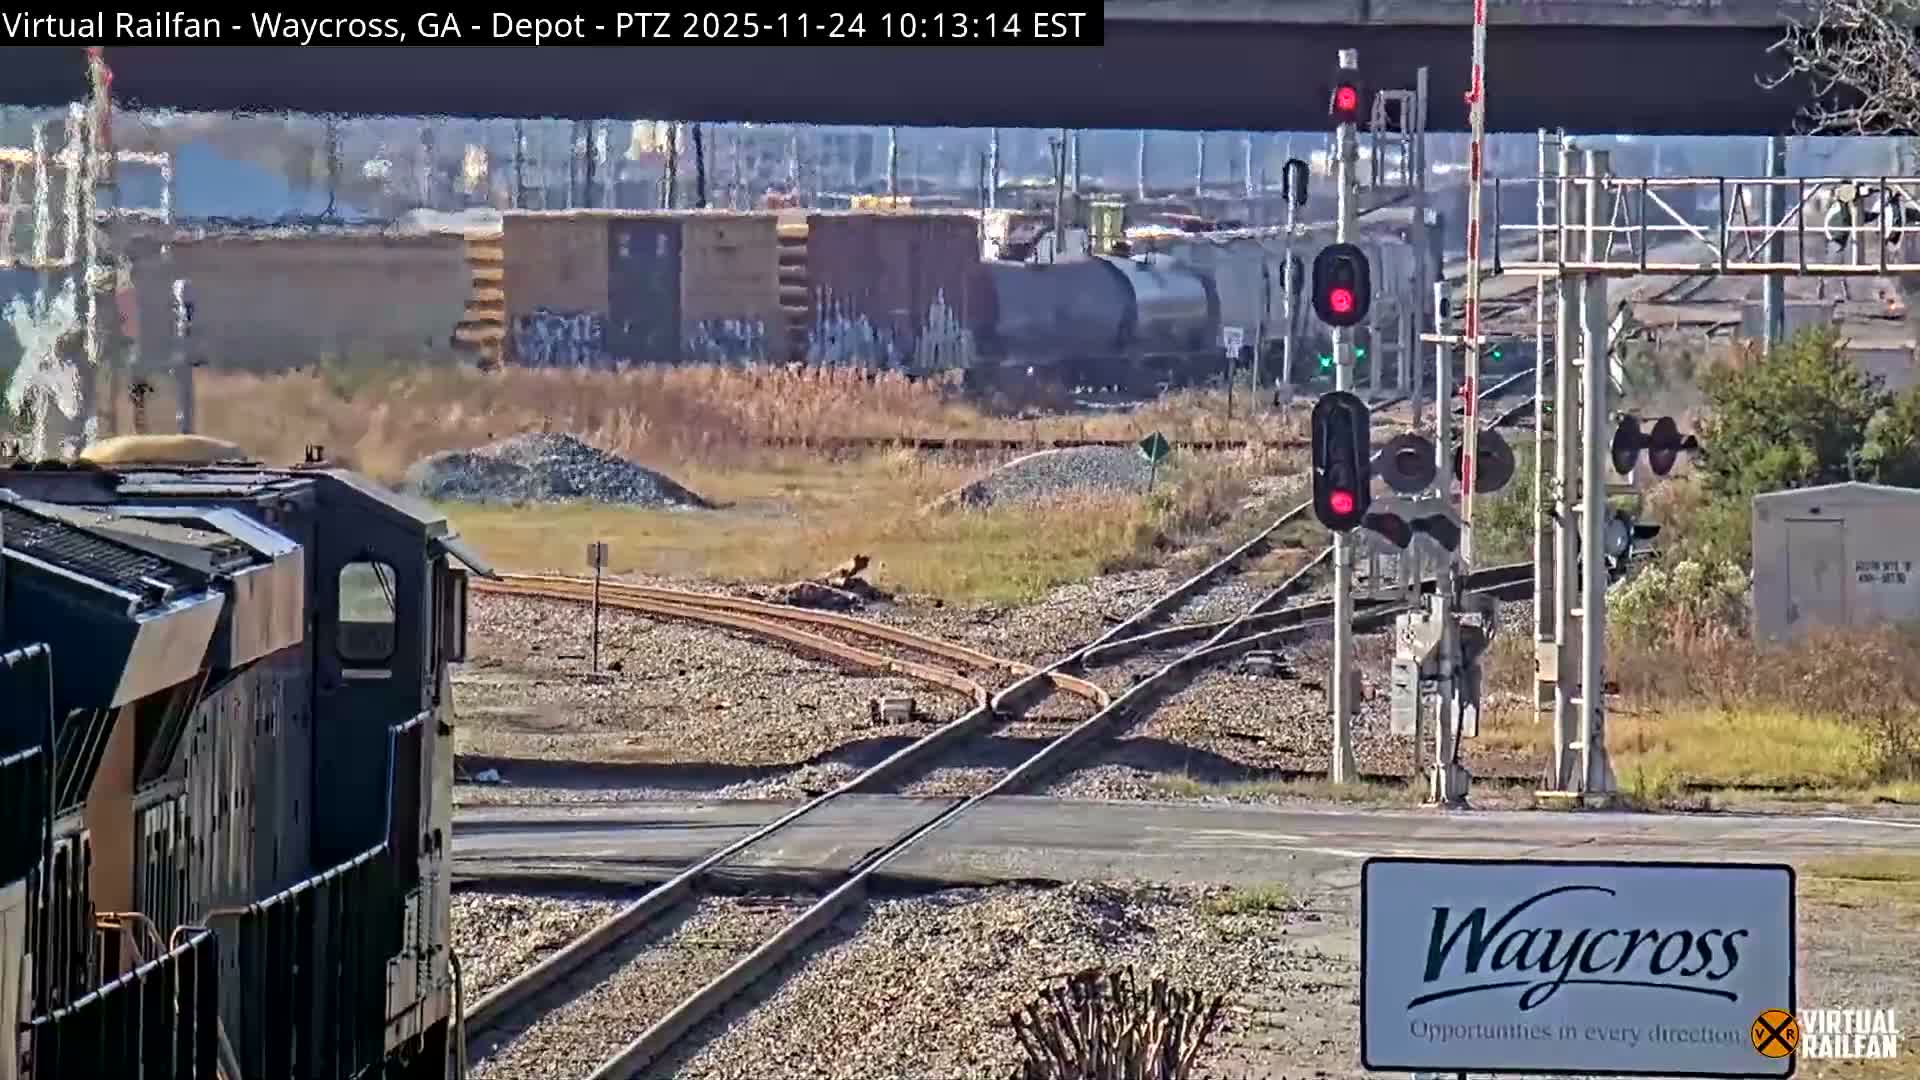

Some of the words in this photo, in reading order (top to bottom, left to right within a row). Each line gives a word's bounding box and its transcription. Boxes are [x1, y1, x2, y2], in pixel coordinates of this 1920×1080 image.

[1424, 885, 1749, 1011] Waycross
[1410, 1019, 1552, 1042] Opportunities
[1559, 1022, 1577, 1040] in
[1585, 1025, 1641, 1047] every
